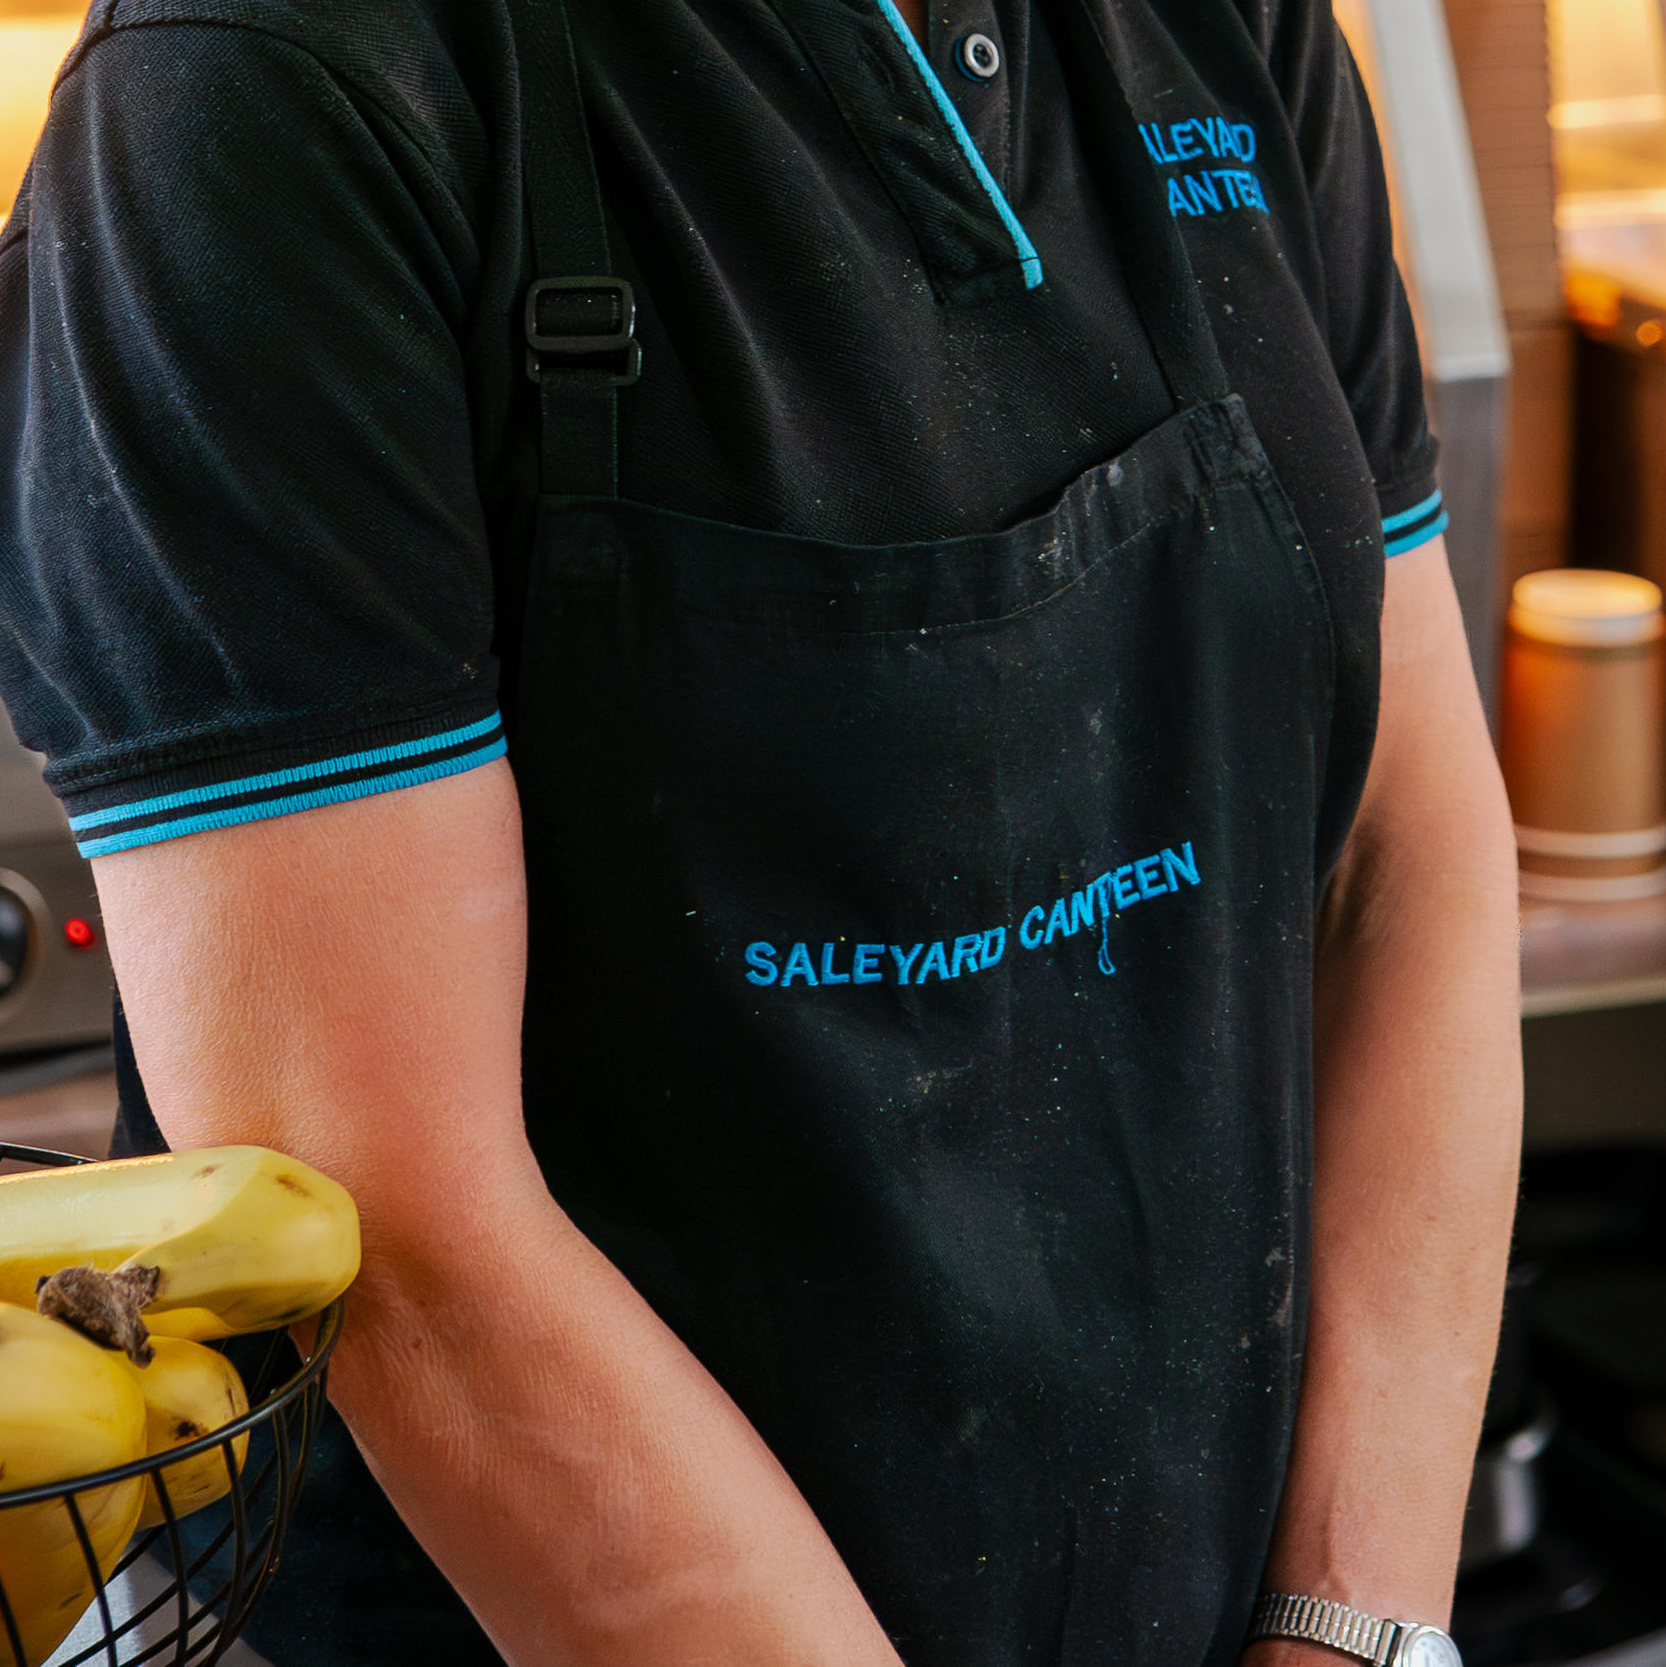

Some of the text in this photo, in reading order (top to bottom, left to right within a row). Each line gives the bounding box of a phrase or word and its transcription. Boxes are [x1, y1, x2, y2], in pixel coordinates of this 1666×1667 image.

[1166, 168, 1271, 218] ANTE
[744, 840, 1201, 987] SALEYARD CANTEEN
